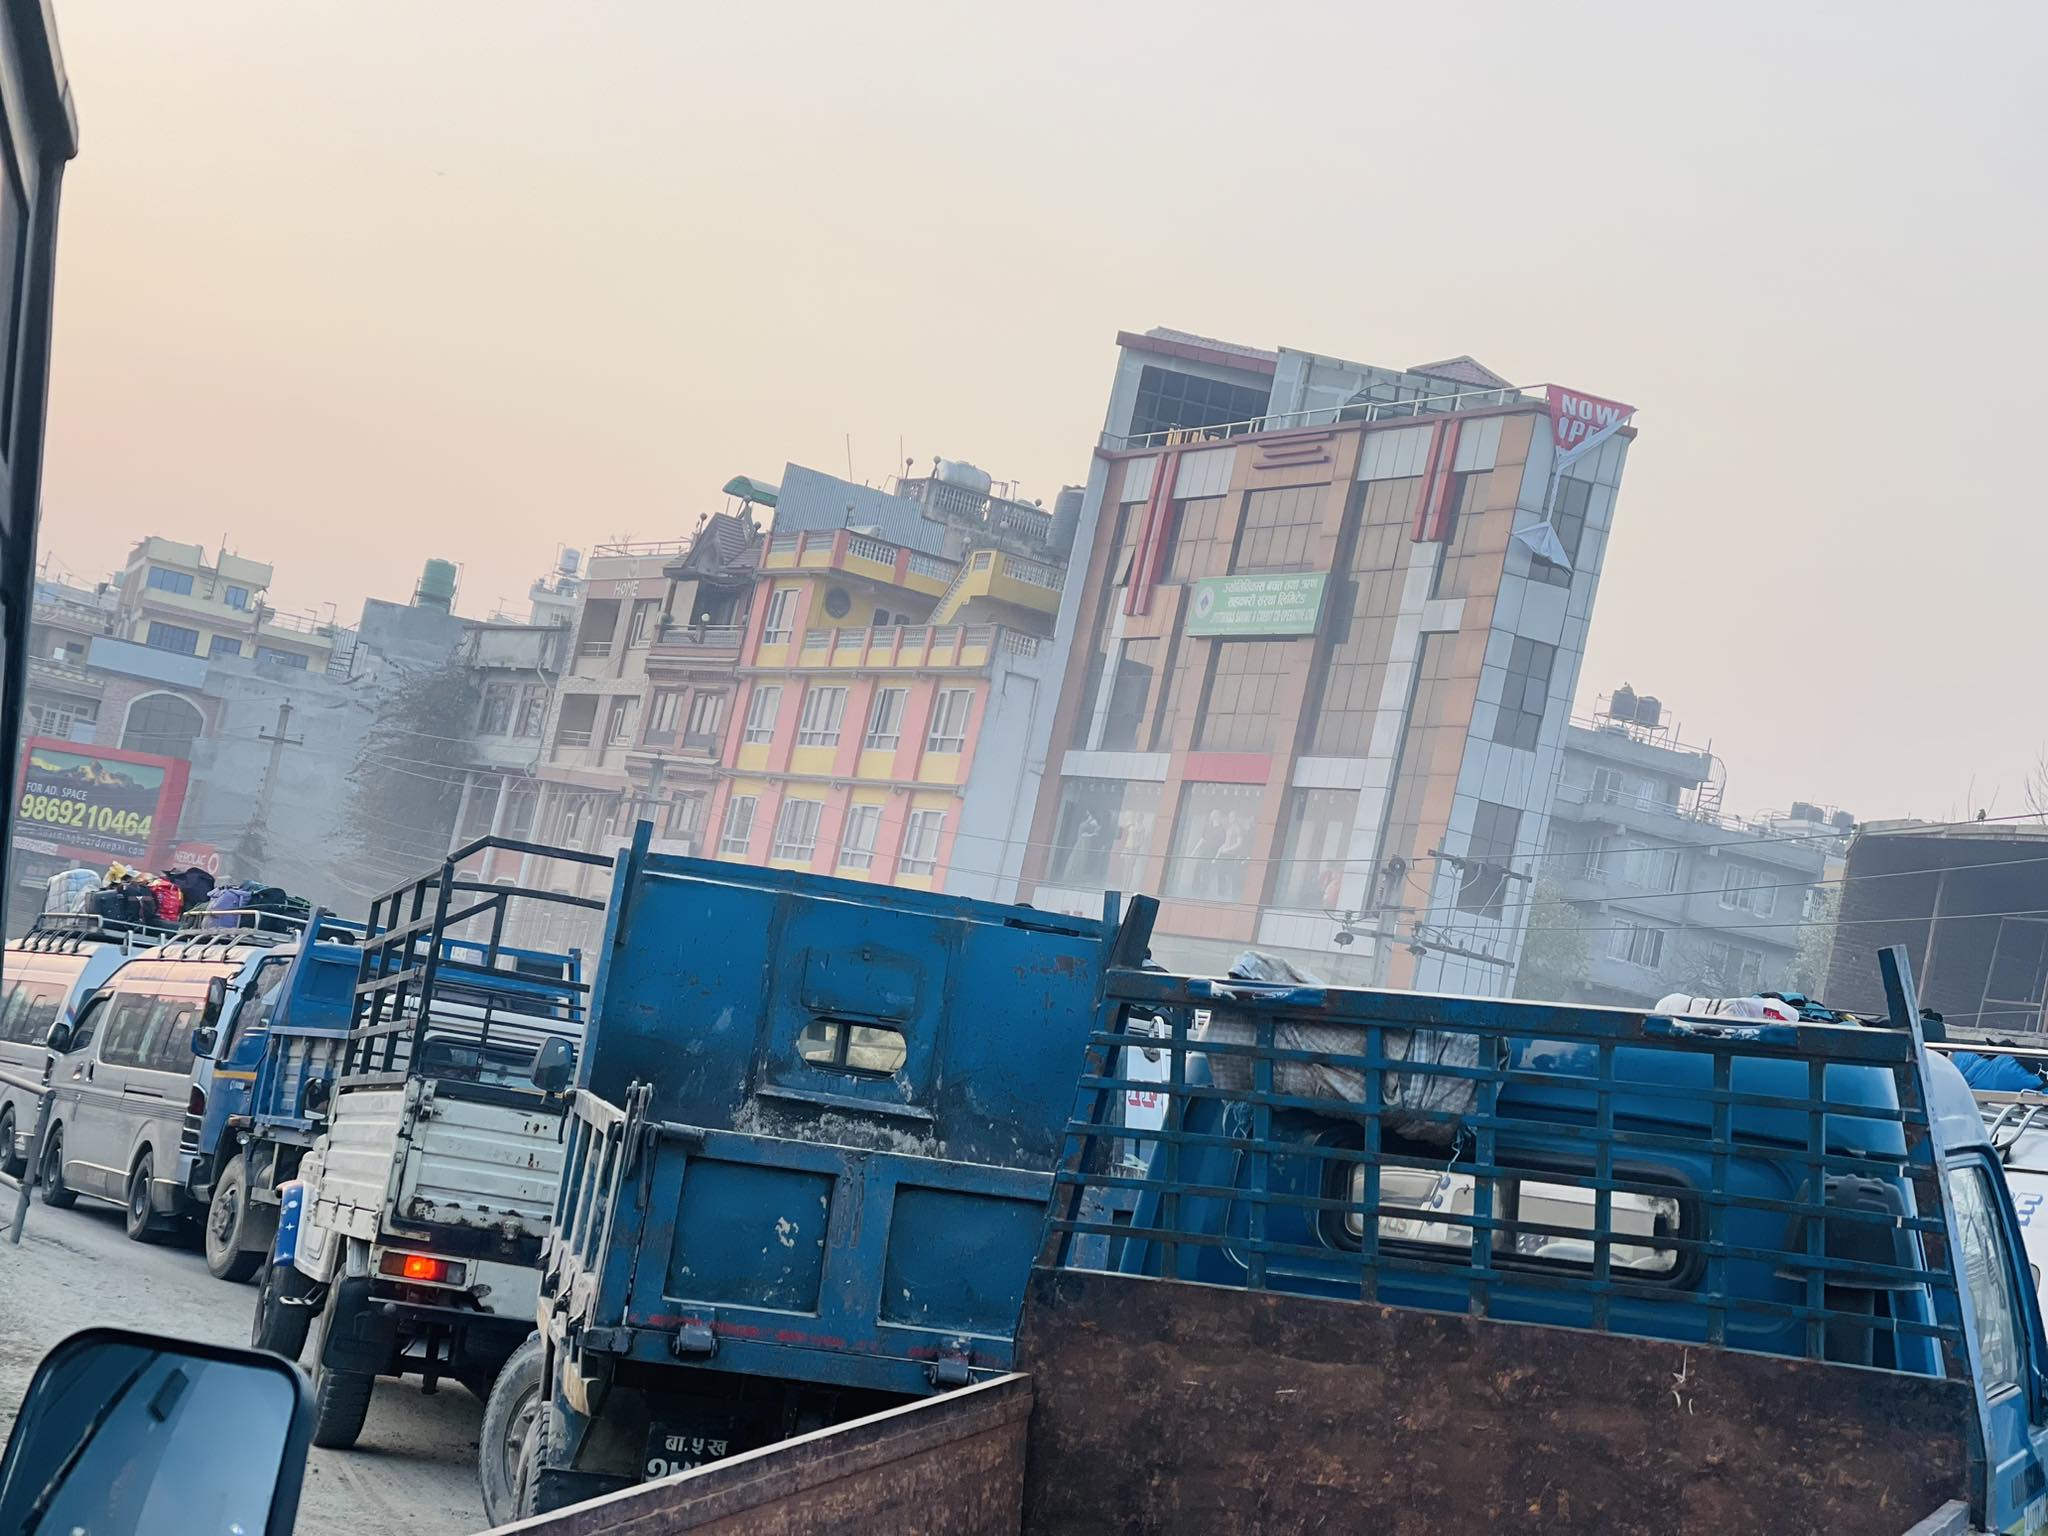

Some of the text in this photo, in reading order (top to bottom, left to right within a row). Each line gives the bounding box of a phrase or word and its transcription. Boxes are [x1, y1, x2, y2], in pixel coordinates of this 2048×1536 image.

[1561, 393, 1620, 426] NOW
[614, 580, 640, 598] HOME
[25, 781, 88, 801] FOR AD. SPACE
[20, 793, 152, 840] 9869210464
